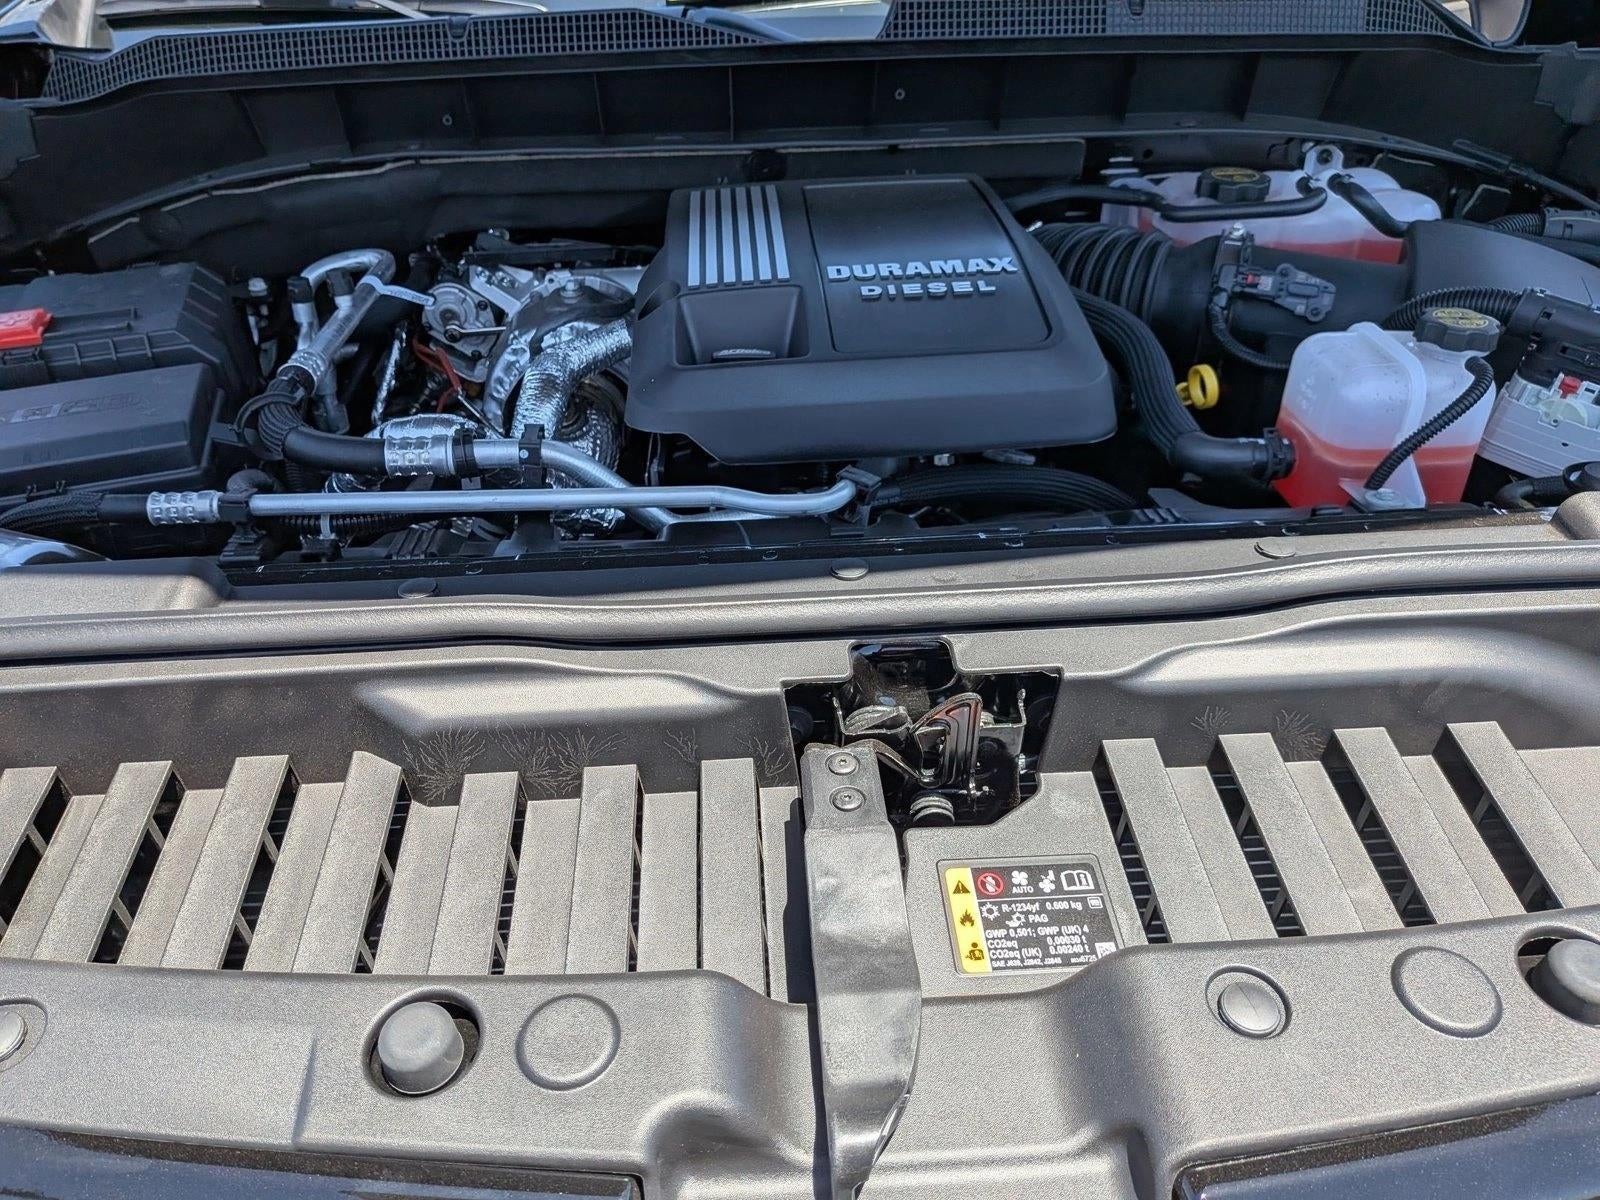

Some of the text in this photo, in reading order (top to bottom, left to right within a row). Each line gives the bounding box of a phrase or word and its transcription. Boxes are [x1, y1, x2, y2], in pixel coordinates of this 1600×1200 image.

[826, 257, 1018, 281] DURAMAX
[860, 281, 996, 299] DIESEL
[1012, 886, 1034, 894] AUTO
[1001, 902, 1039, 912] R-1234yf
[1070, 900, 1082, 910] kg
[1028, 914, 1048, 923] PAG
[985, 929, 1008, 938] GWP
[1037, 926, 1059, 936] GWP
[1061, 924, 1081, 936] (UK)
[1083, 924, 1089, 933] 4
[987, 939, 1018, 949] CO2eq
[1082, 934, 1087, 943] t
[989, 949, 1021, 959] CO2eq
[1021, 947, 1042, 959] (UK)
[1084, 944, 1090, 952] t
